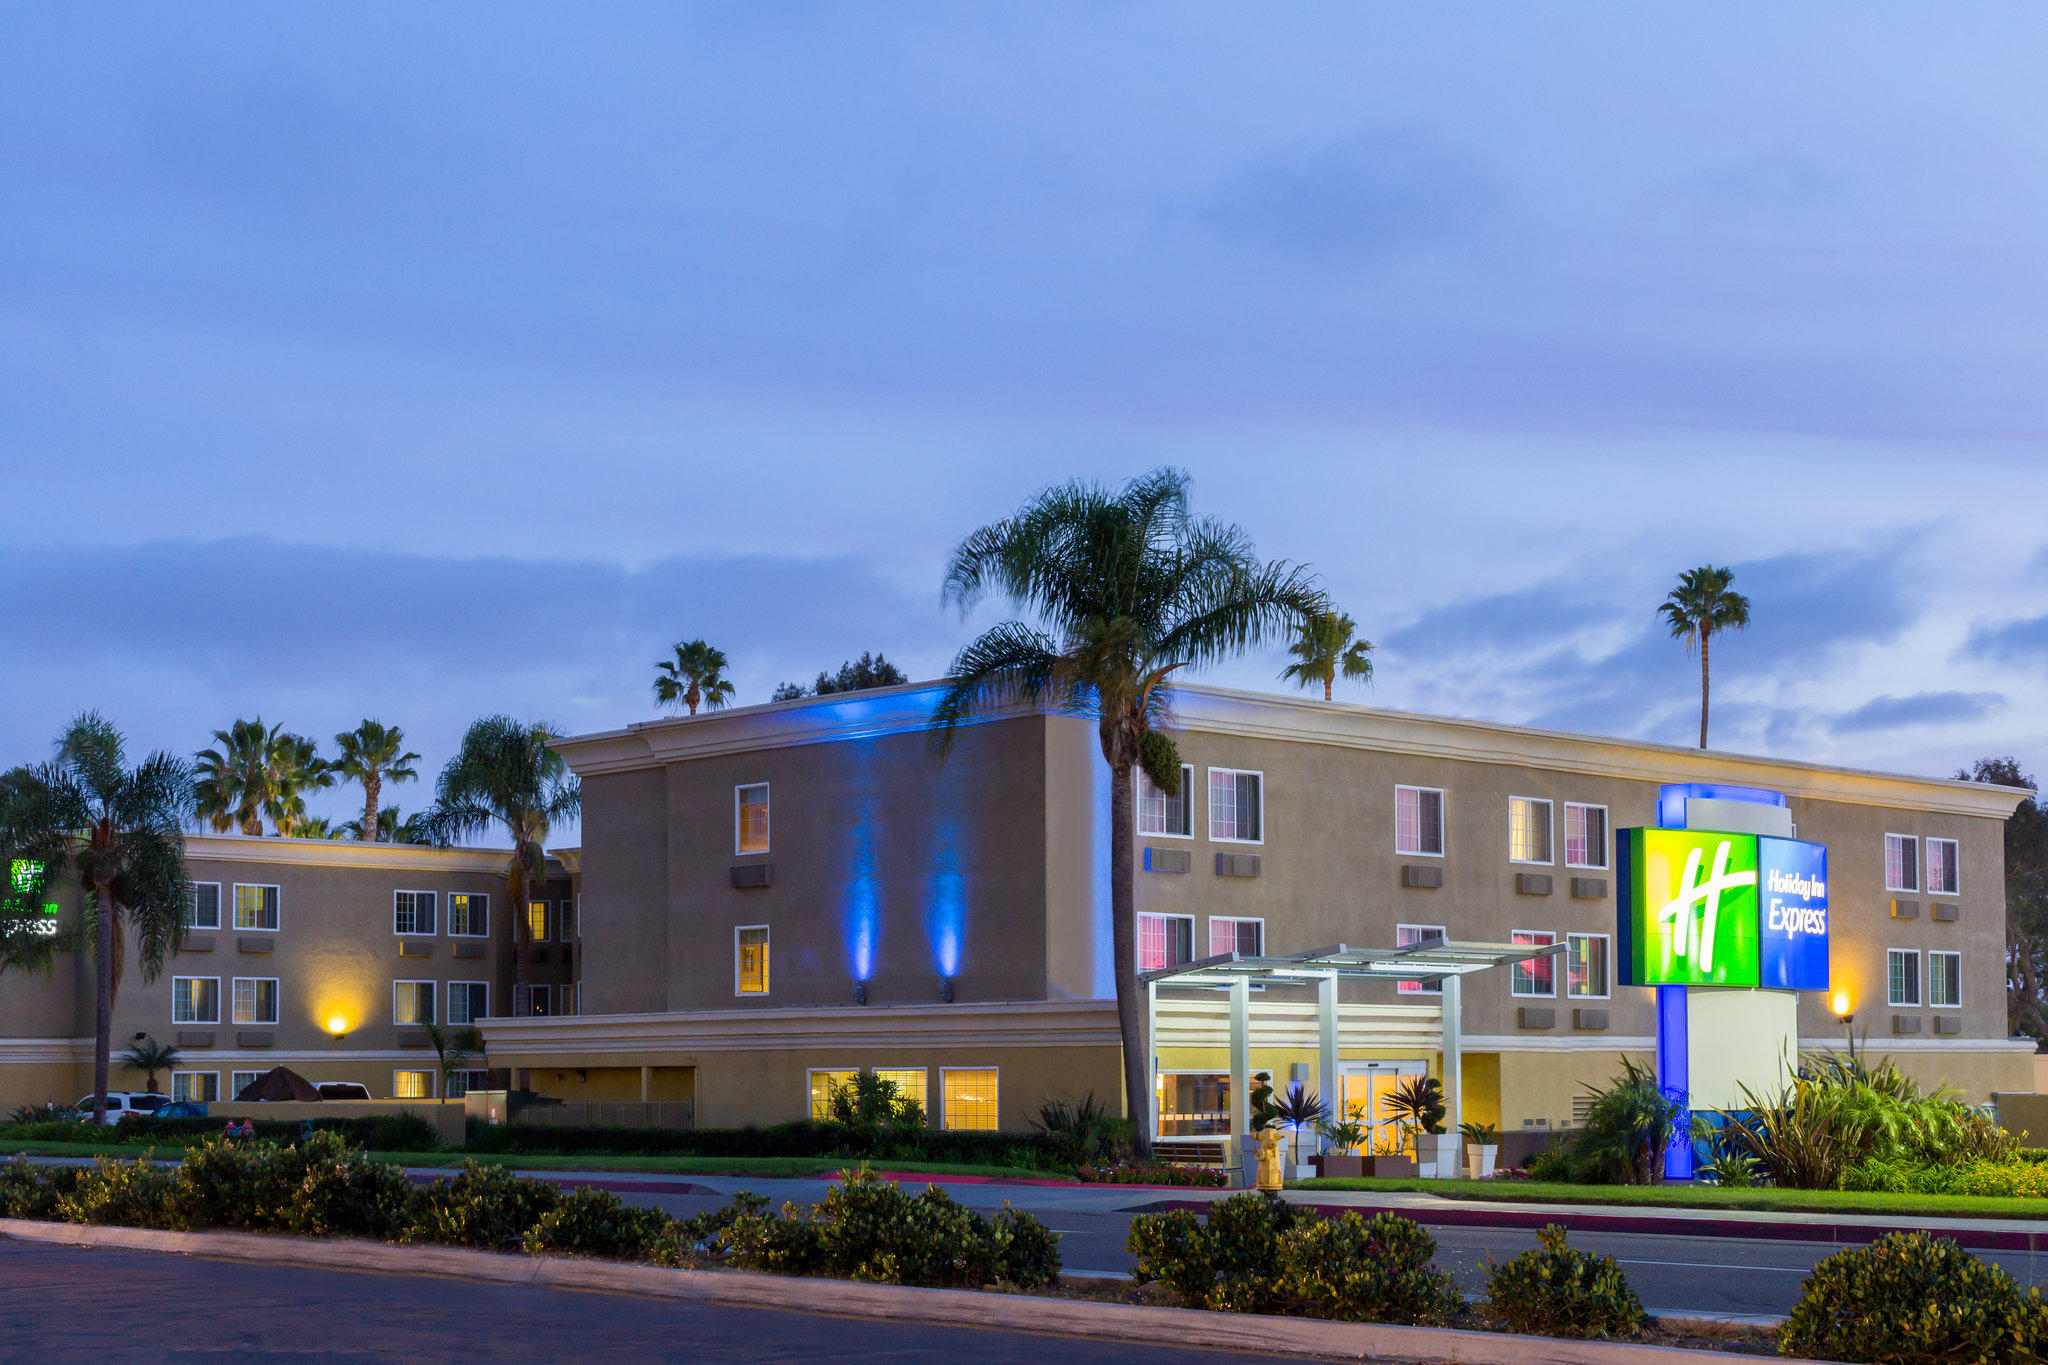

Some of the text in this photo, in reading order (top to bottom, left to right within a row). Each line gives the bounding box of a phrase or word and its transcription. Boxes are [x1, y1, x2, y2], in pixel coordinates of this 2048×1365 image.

[1768, 869, 1825, 901] Holiday Inn
[1658, 841, 1756, 972] H
[1768, 898, 1826, 940] Express
